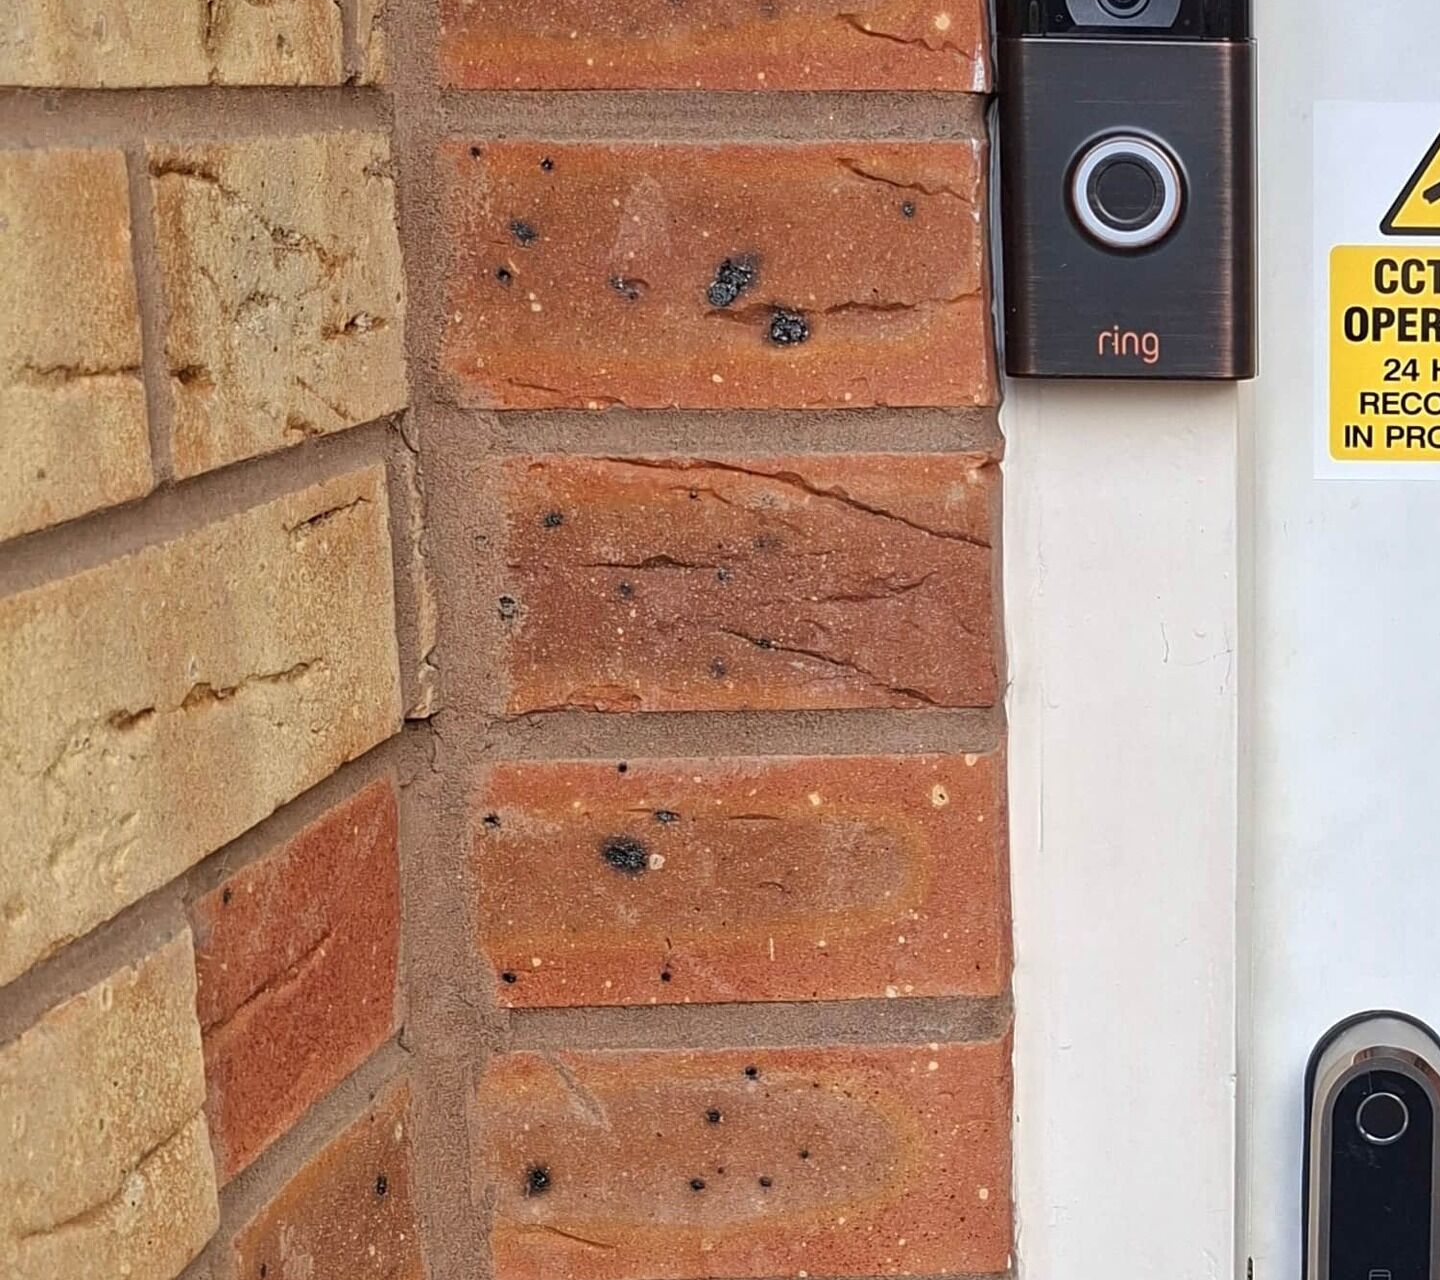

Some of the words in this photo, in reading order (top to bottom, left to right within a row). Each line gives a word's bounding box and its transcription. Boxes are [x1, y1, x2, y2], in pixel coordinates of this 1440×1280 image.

[1098, 324, 1159, 364] ring
[1383, 358, 1420, 382] 24
[1344, 425, 1373, 449] IN
